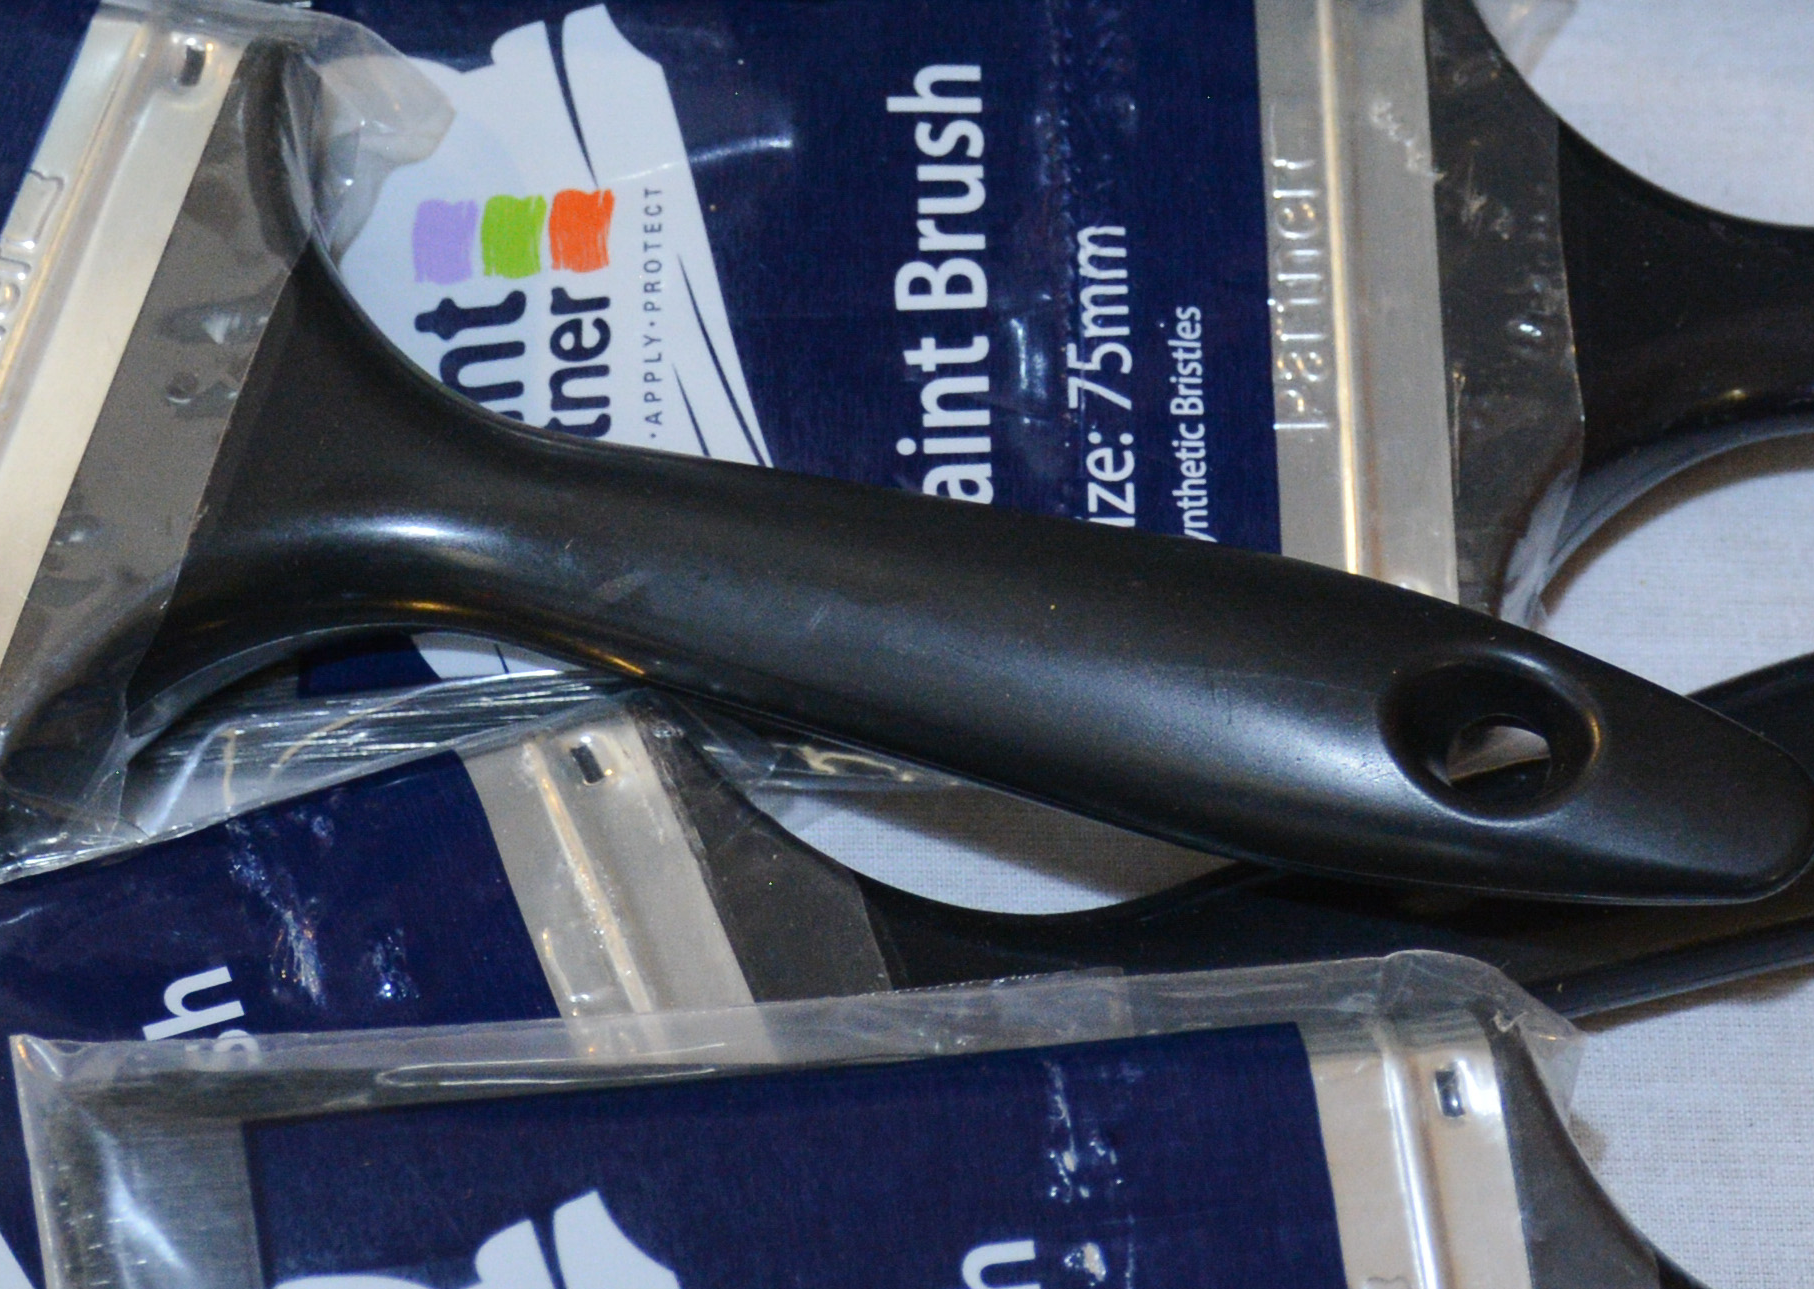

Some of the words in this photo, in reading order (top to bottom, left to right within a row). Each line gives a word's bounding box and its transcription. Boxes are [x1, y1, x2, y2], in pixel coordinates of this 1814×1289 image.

[886, 64, 988, 311] Brush
[1067, 225, 1133, 411] 75mm
[1168, 305, 1205, 417] Bristles
[897, 335, 994, 505] aint
[1086, 431, 1135, 528] ize:
[1171, 423, 1218, 543] ynthetic
